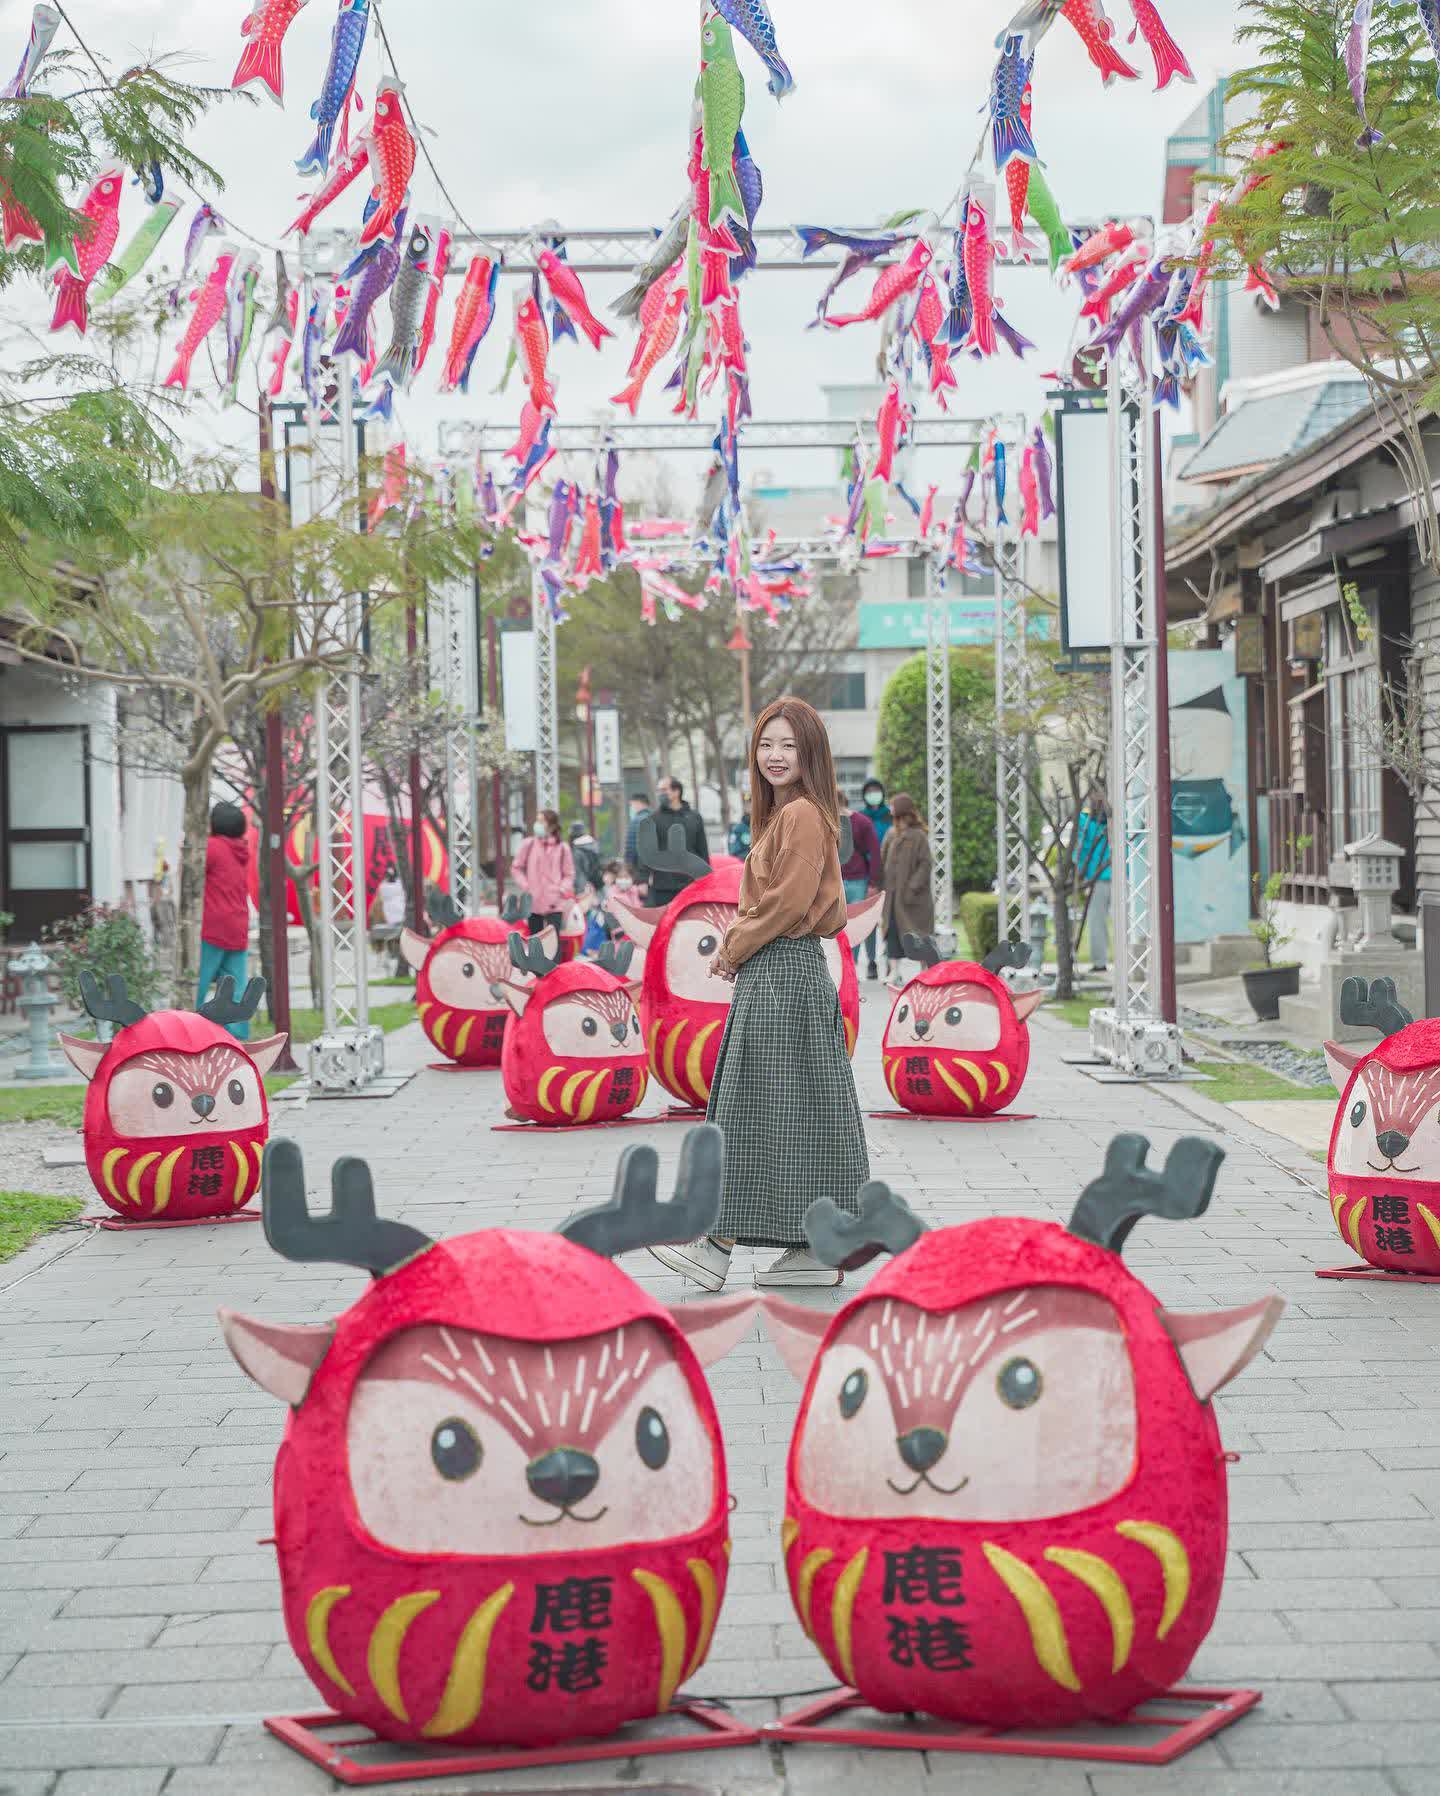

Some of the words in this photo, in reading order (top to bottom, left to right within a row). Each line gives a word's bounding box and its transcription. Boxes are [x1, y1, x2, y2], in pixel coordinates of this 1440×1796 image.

[607, 1067, 634, 1104] 鹿港
[905, 1056, 932, 1095] 鹿港
[188, 1145, 224, 1196] 鹿港
[1372, 1195, 1414, 1254] 鹿港
[527, 1576, 614, 1694] 鹿港
[882, 1544, 974, 1671] 鹿港
